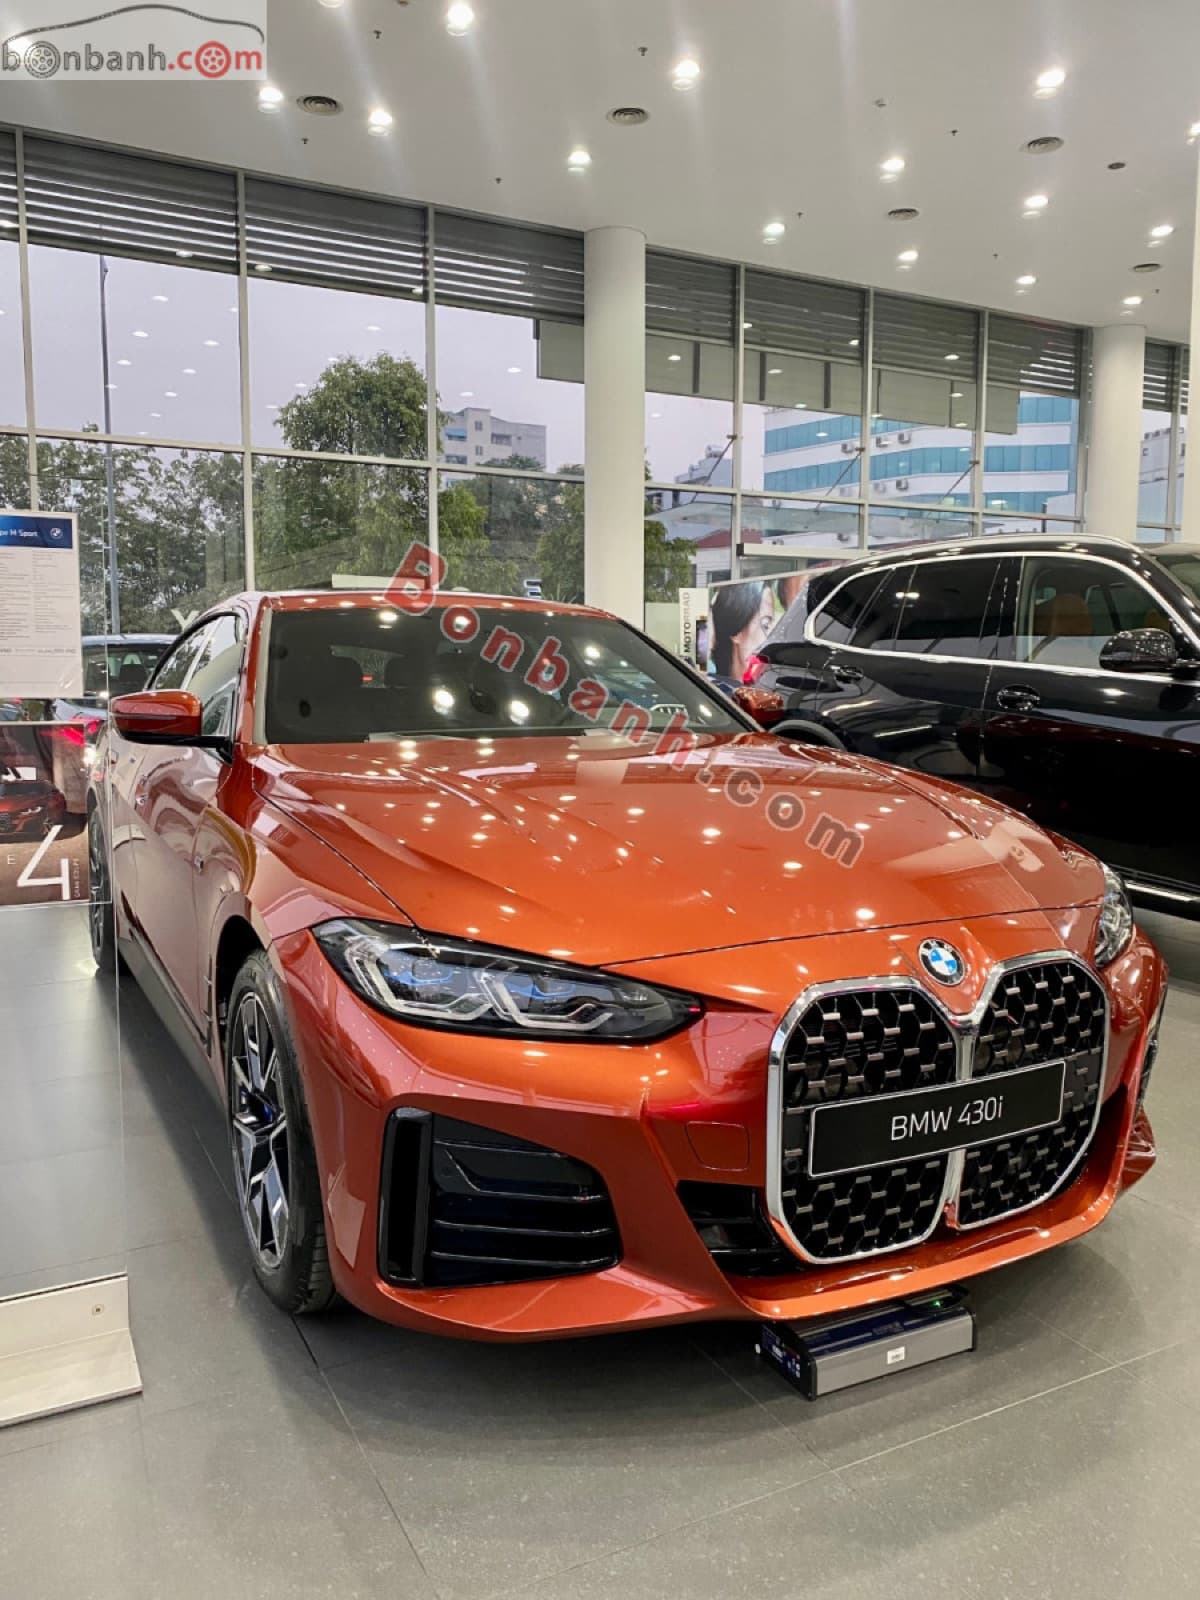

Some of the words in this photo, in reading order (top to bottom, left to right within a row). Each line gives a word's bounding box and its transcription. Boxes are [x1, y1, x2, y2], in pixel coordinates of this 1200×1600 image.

[16, 824, 71, 900] 4
[891, 1105, 953, 1141] BMW
[957, 1095, 1004, 1125] 430i
